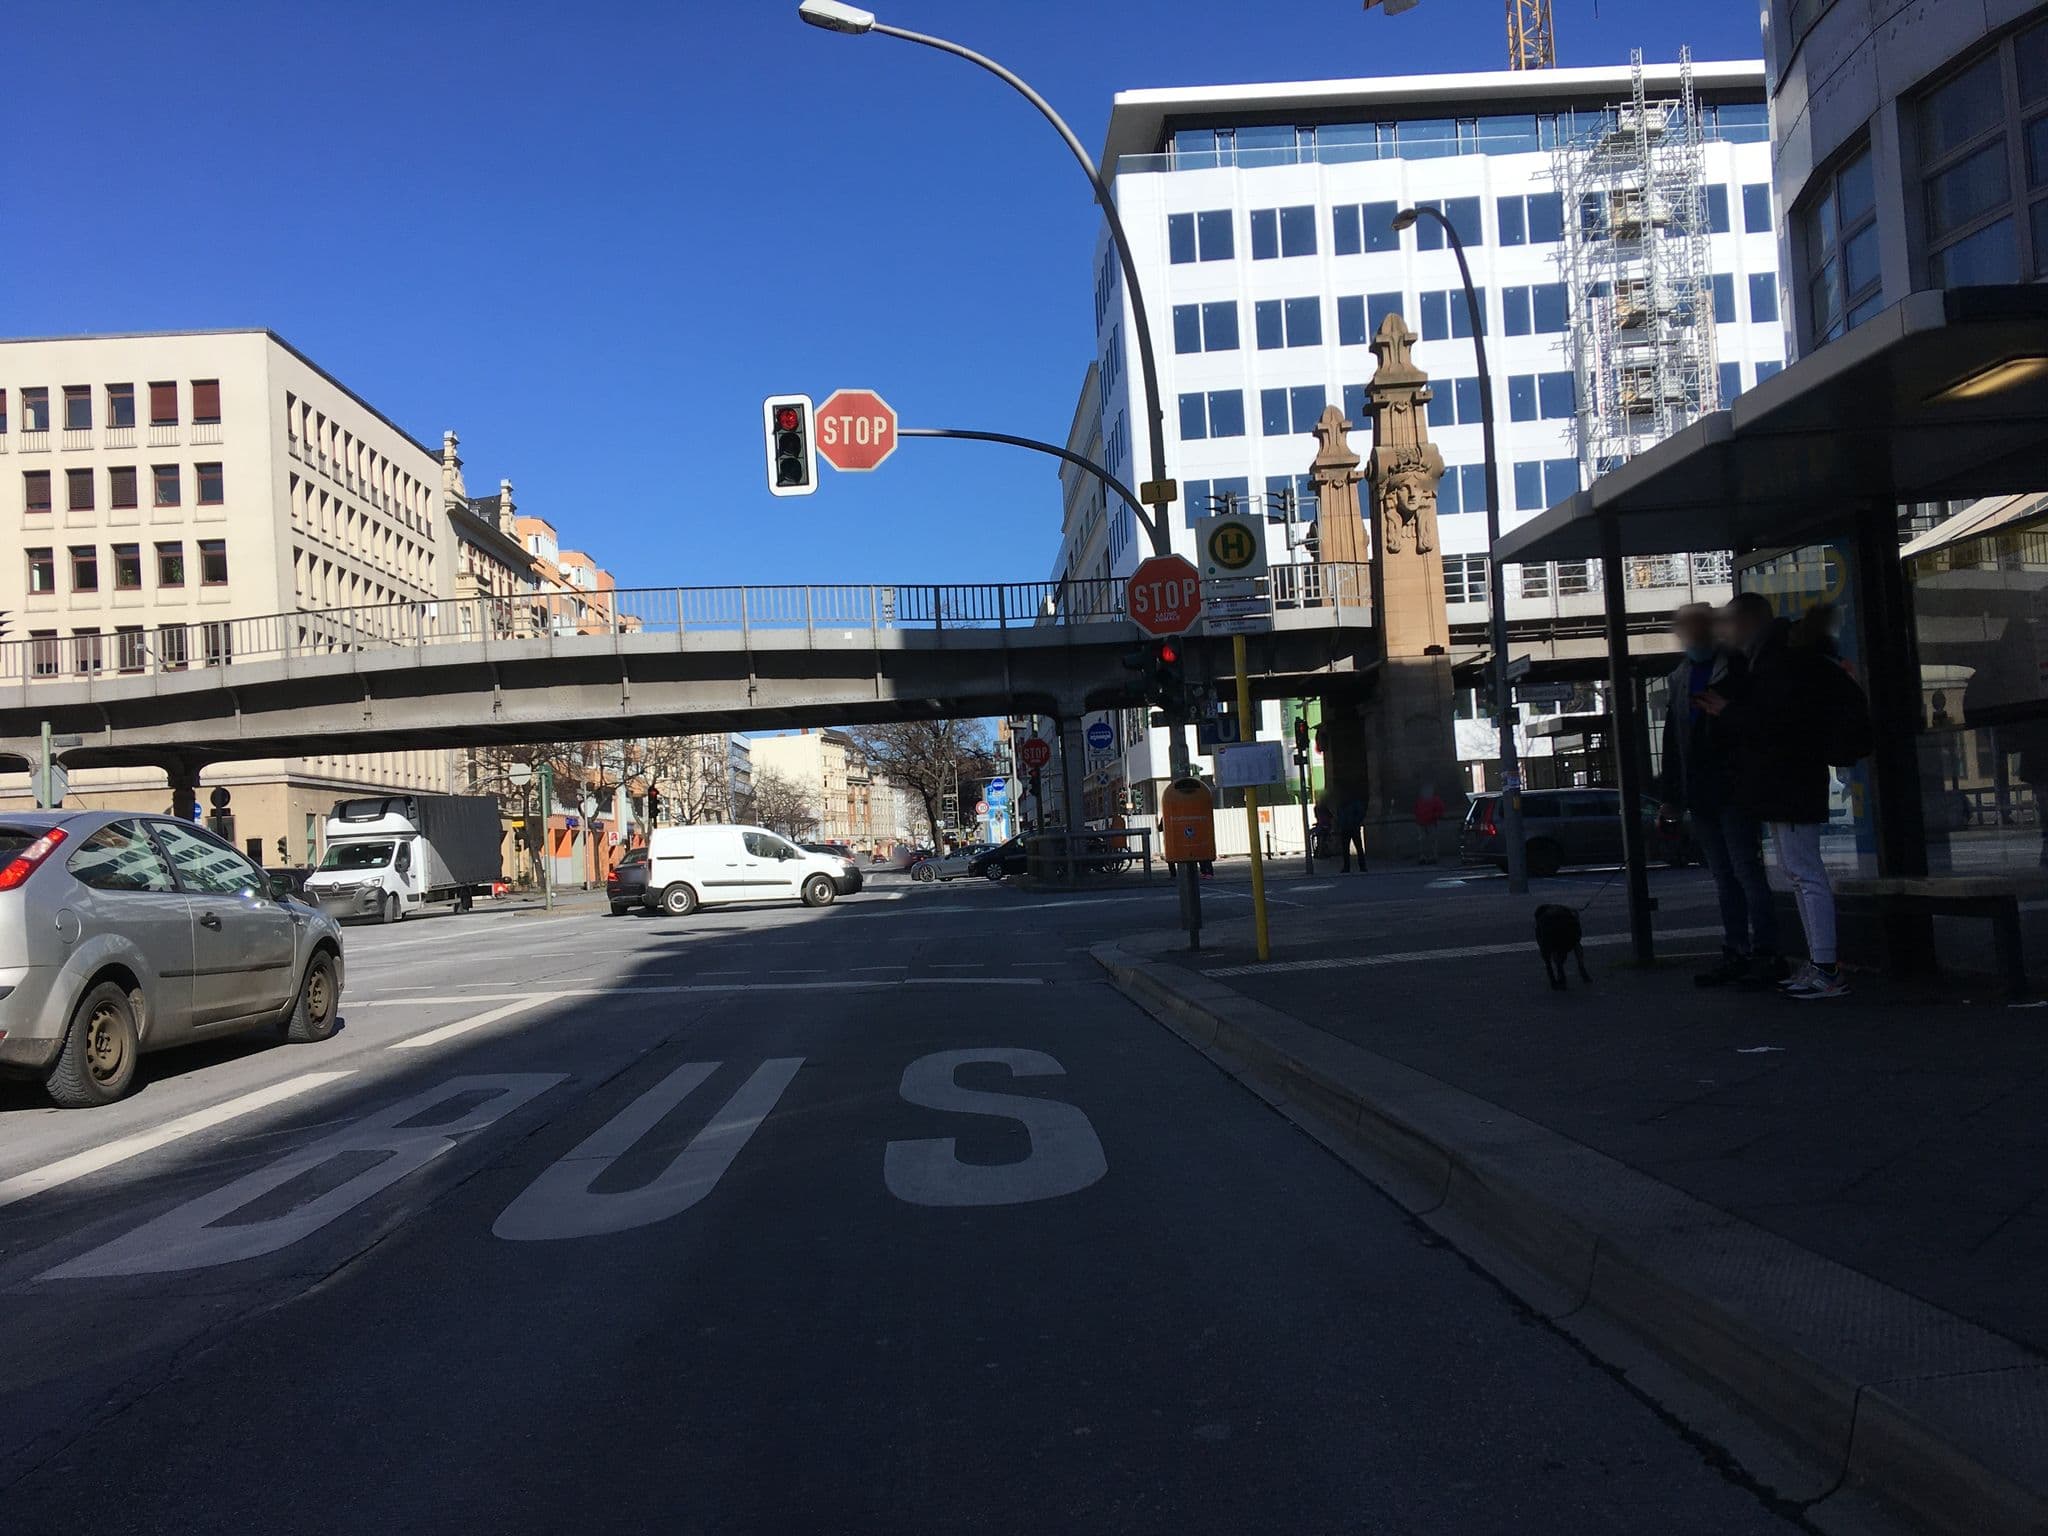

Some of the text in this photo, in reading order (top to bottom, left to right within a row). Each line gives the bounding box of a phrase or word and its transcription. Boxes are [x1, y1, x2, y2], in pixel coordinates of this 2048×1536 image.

[823, 415, 888, 446] STOP
[1220, 533, 1245, 560] H
[1134, 577, 1197, 614] STOP
[1216, 719, 1236, 743] U
[1023, 745, 1049, 760] STOP
[28, 1047, 1108, 1282] BUS
